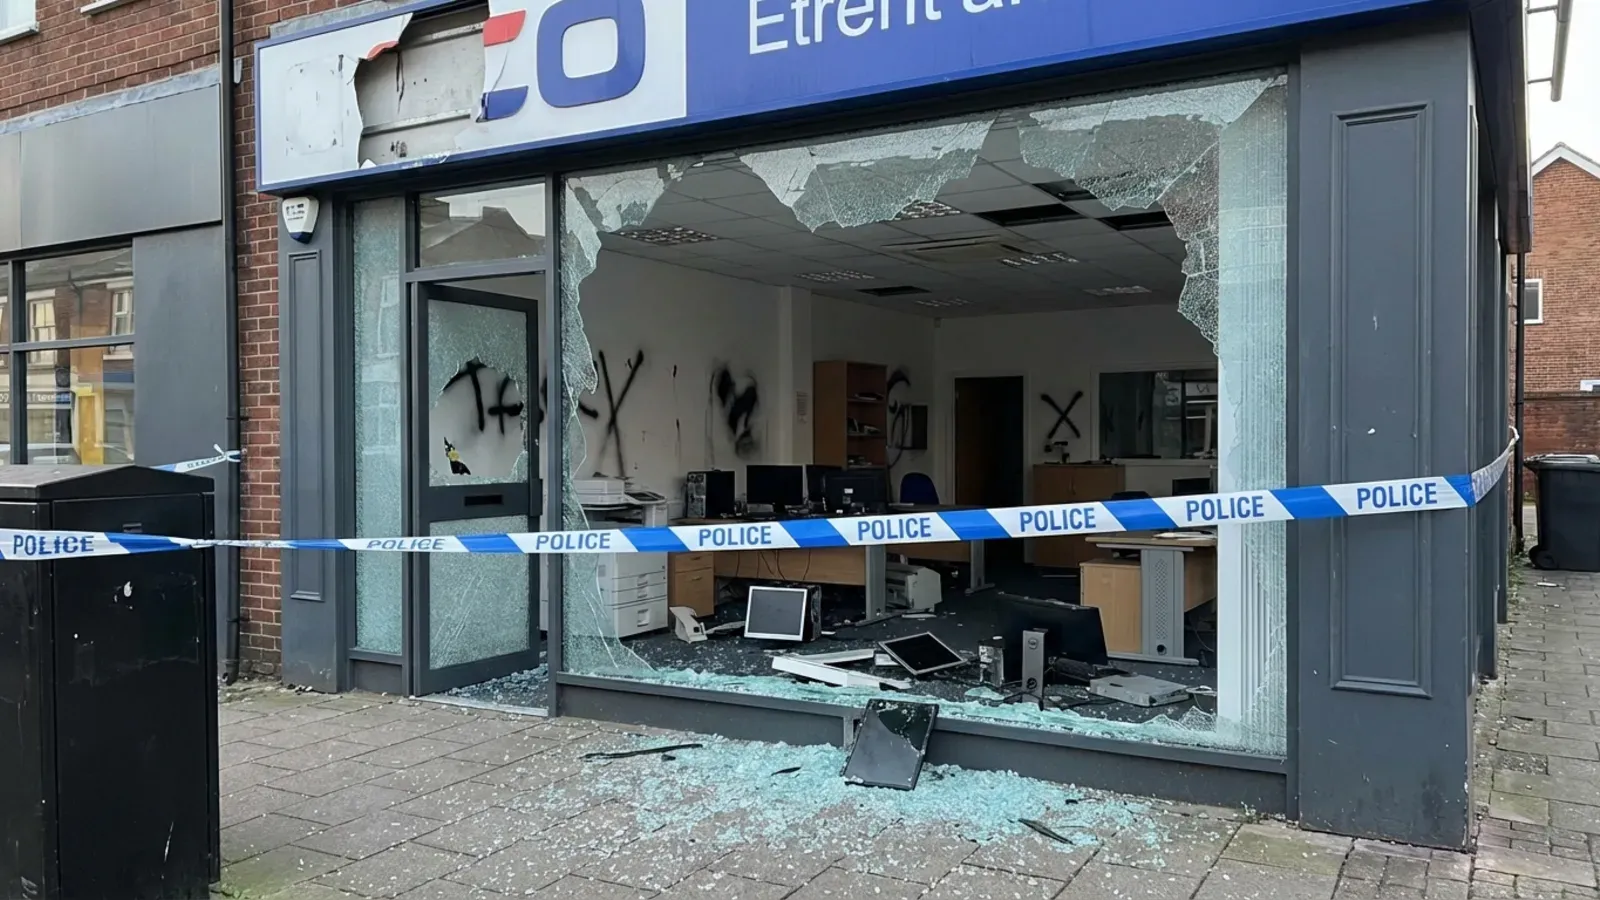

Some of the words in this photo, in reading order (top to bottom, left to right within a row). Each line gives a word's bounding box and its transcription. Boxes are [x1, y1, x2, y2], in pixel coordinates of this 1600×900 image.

[13, 534, 94, 555] POLICE
[366, 538, 446, 551] POLICE
[535, 532, 611, 550] POLICE
[699, 525, 772, 546] POLICE
[857, 517, 932, 541] POLICE
[1019, 507, 1097, 532] POLICE
[1186, 495, 1265, 522] POLICE
[1357, 482, 1438, 510] POLICE
